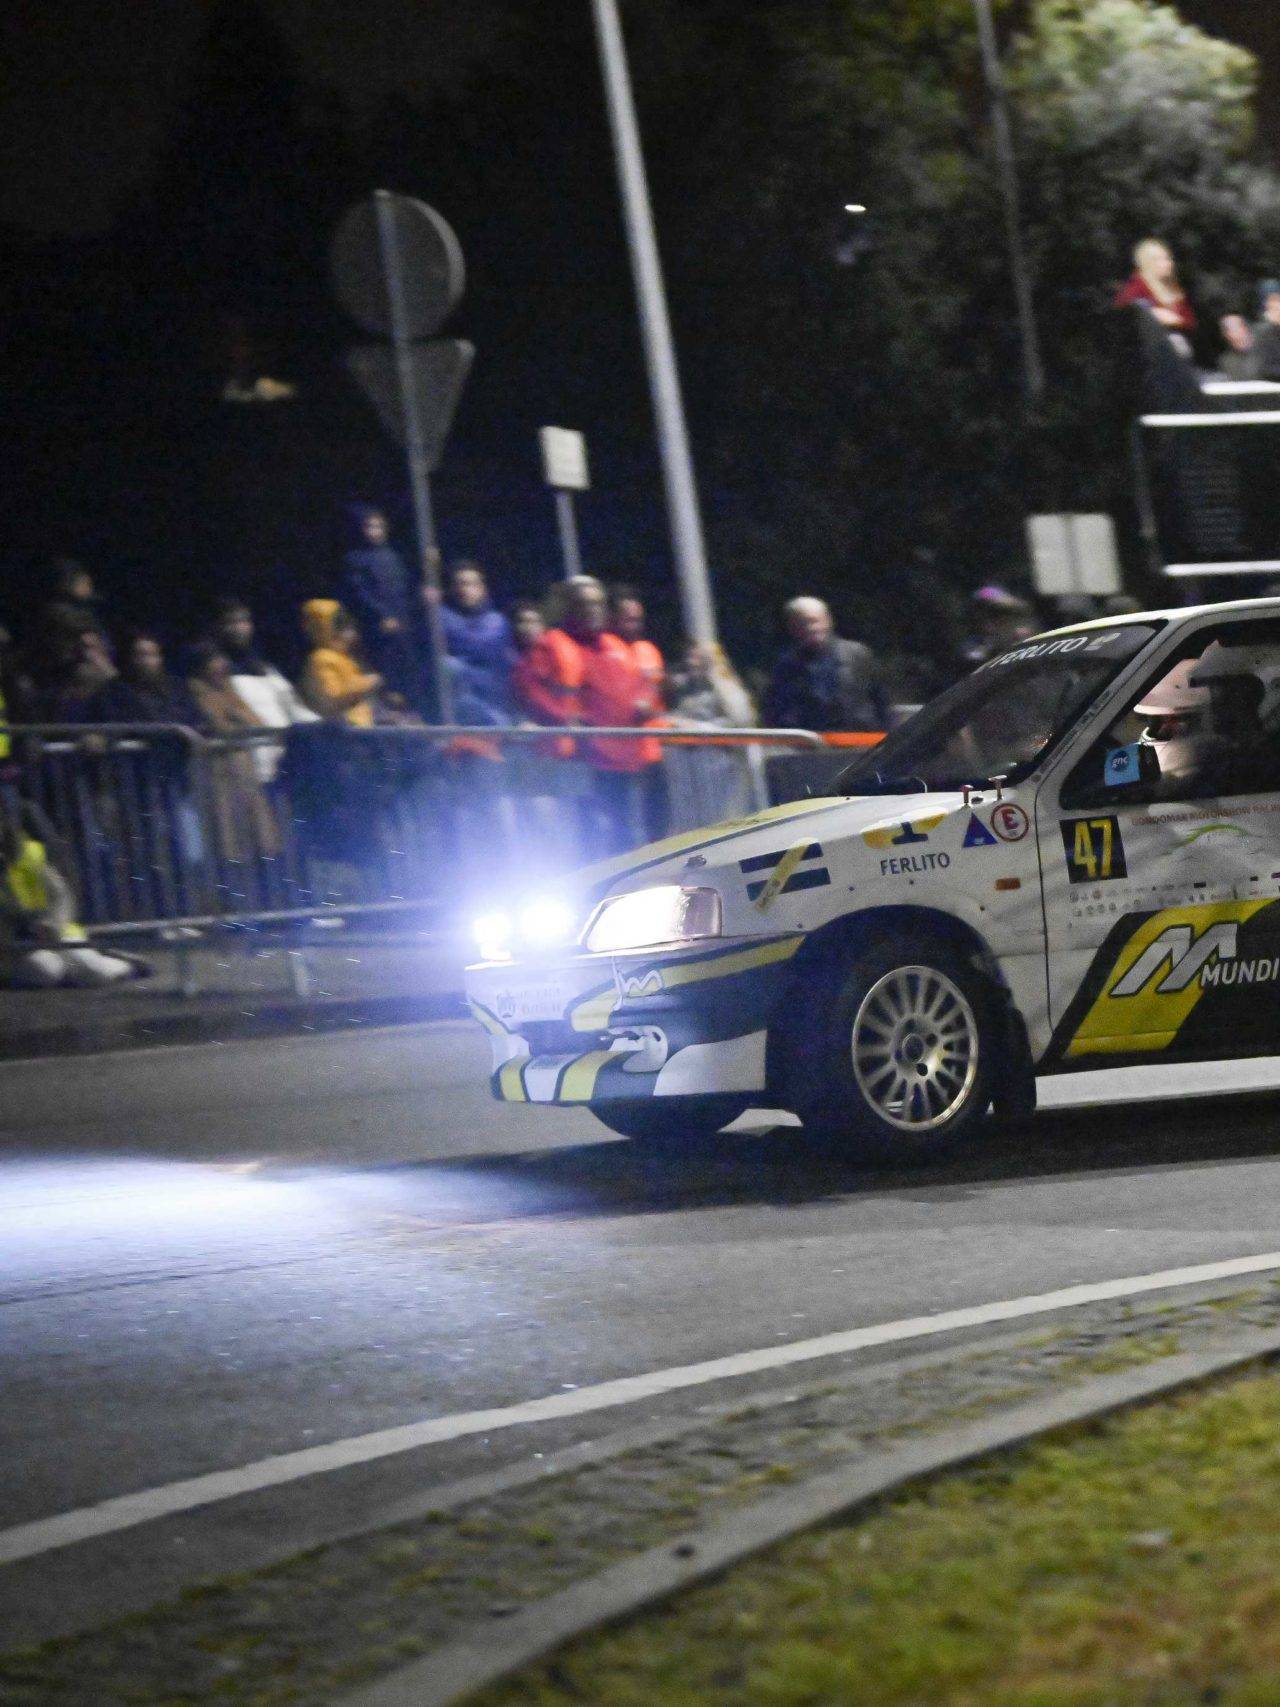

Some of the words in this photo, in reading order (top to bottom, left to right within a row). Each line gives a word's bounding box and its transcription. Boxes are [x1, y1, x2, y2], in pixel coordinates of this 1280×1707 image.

[989, 636, 1088, 669] FERLITO
[1000, 807, 1019, 831] E
[1073, 819, 1112, 879] 47
[880, 852, 951, 876] FERLITO
